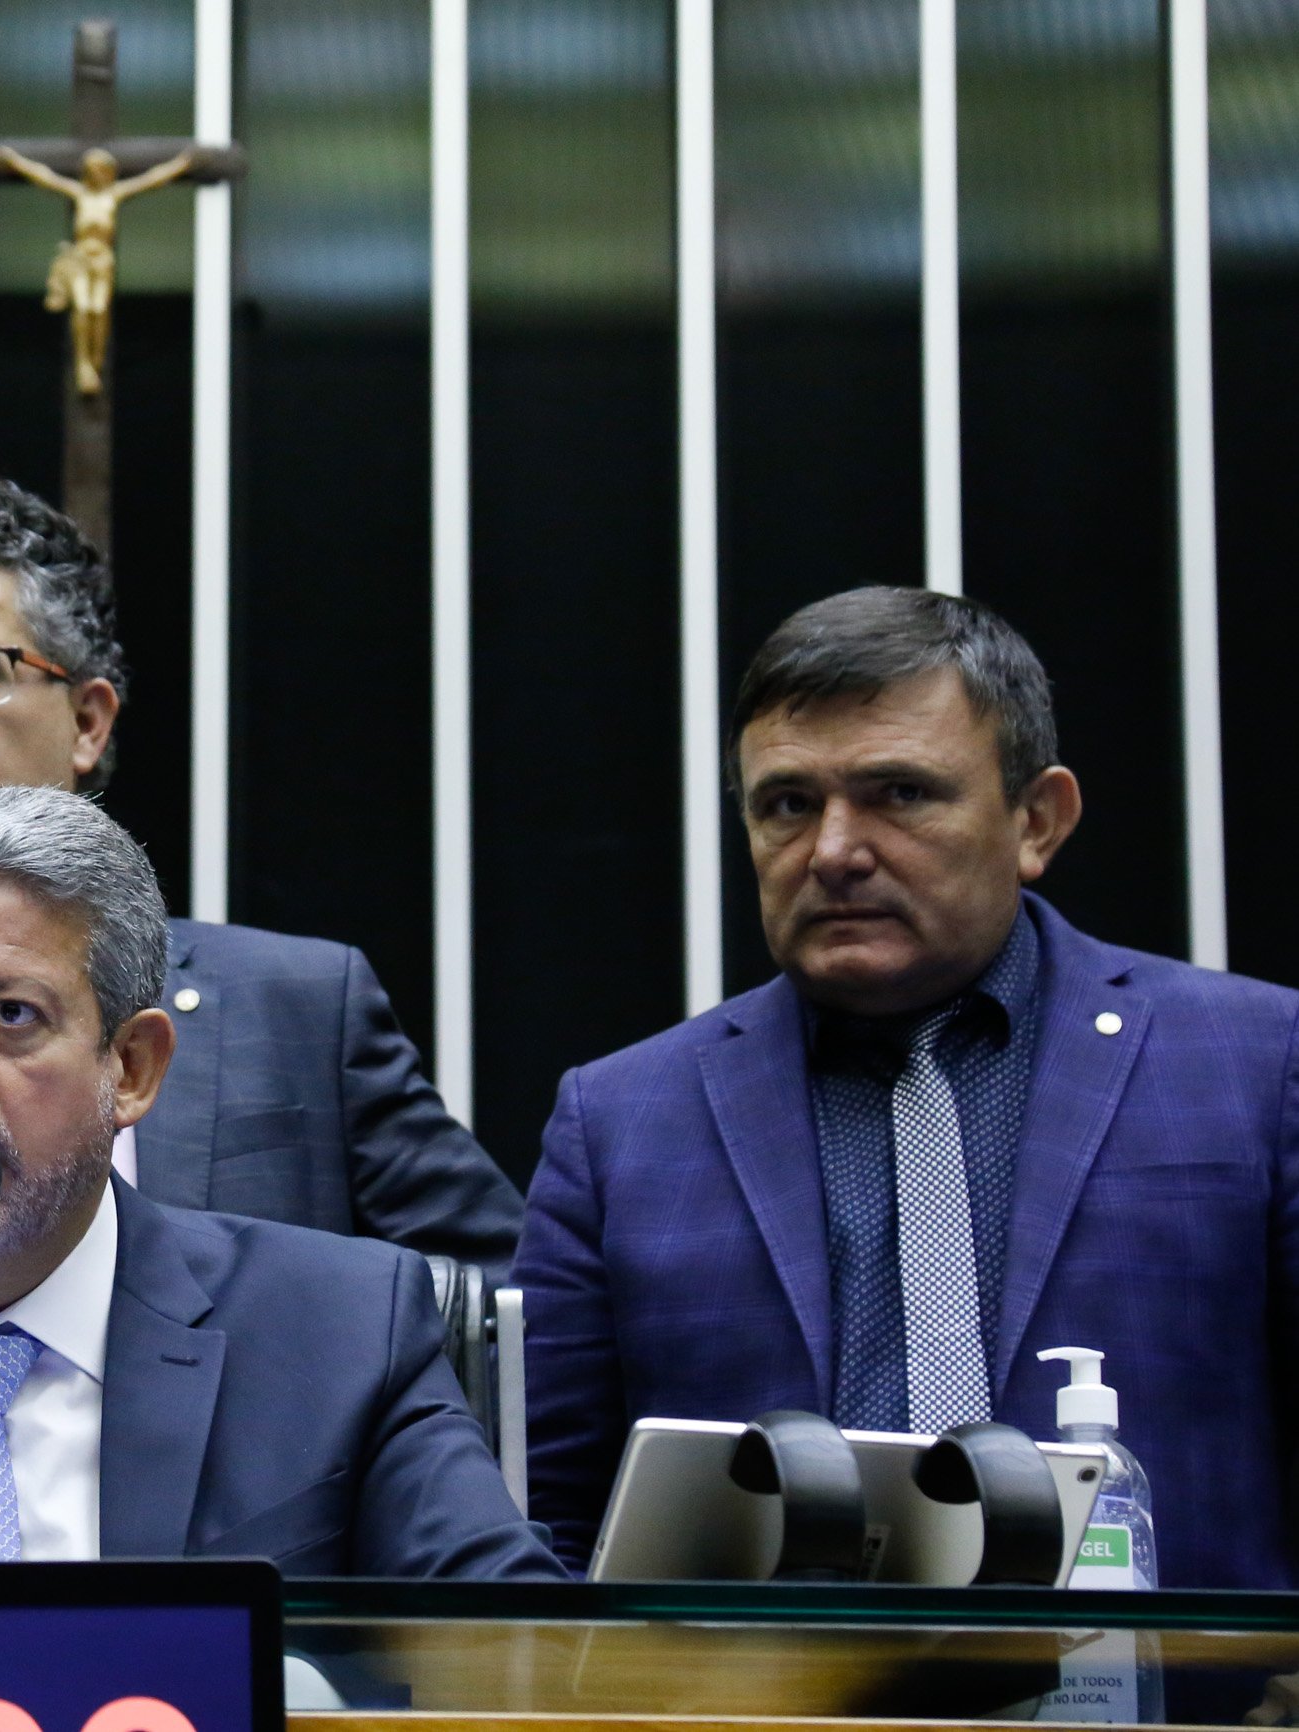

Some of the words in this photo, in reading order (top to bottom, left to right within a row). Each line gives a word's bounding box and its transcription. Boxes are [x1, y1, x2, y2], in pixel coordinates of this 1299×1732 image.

[1080, 1541, 1114, 1557] GEL
[1063, 1677, 1078, 1687] DE
[1082, 1676, 1123, 1688] TODOS
[1053, 1694, 1070, 1704] NO
[1072, 1693, 1110, 1704] LOCAL
